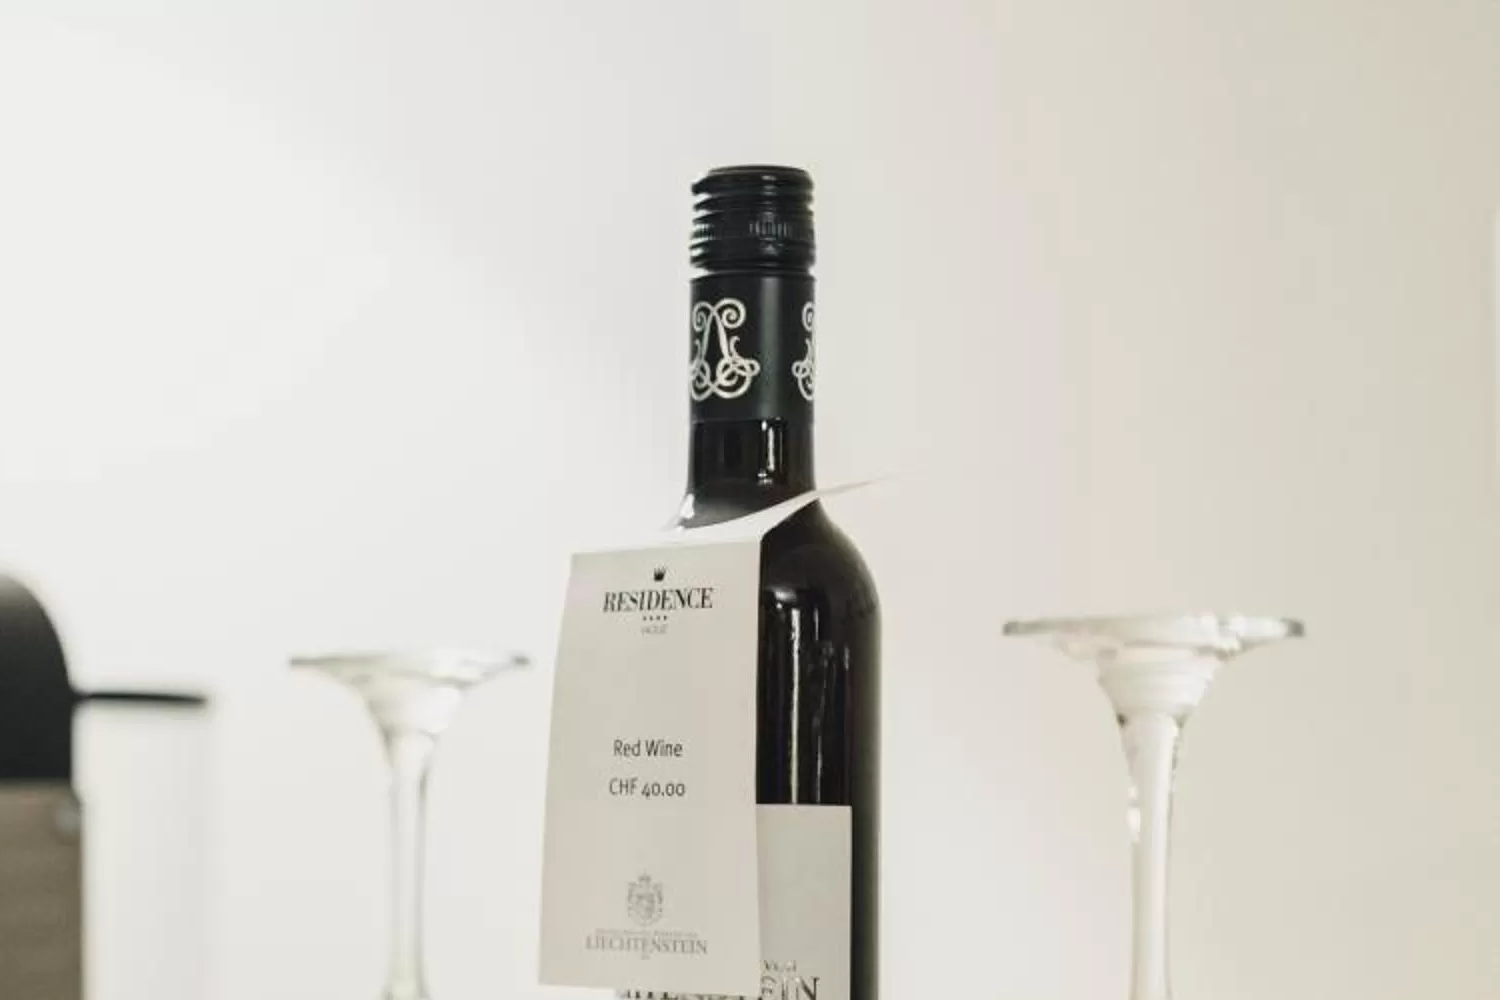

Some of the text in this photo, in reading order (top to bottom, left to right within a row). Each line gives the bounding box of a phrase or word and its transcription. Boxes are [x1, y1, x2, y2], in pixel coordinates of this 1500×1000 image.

[602, 586, 714, 613] RESIDENCE
[613, 739, 683, 758] Red Wine
[608, 777, 686, 798] CHF 40.00
